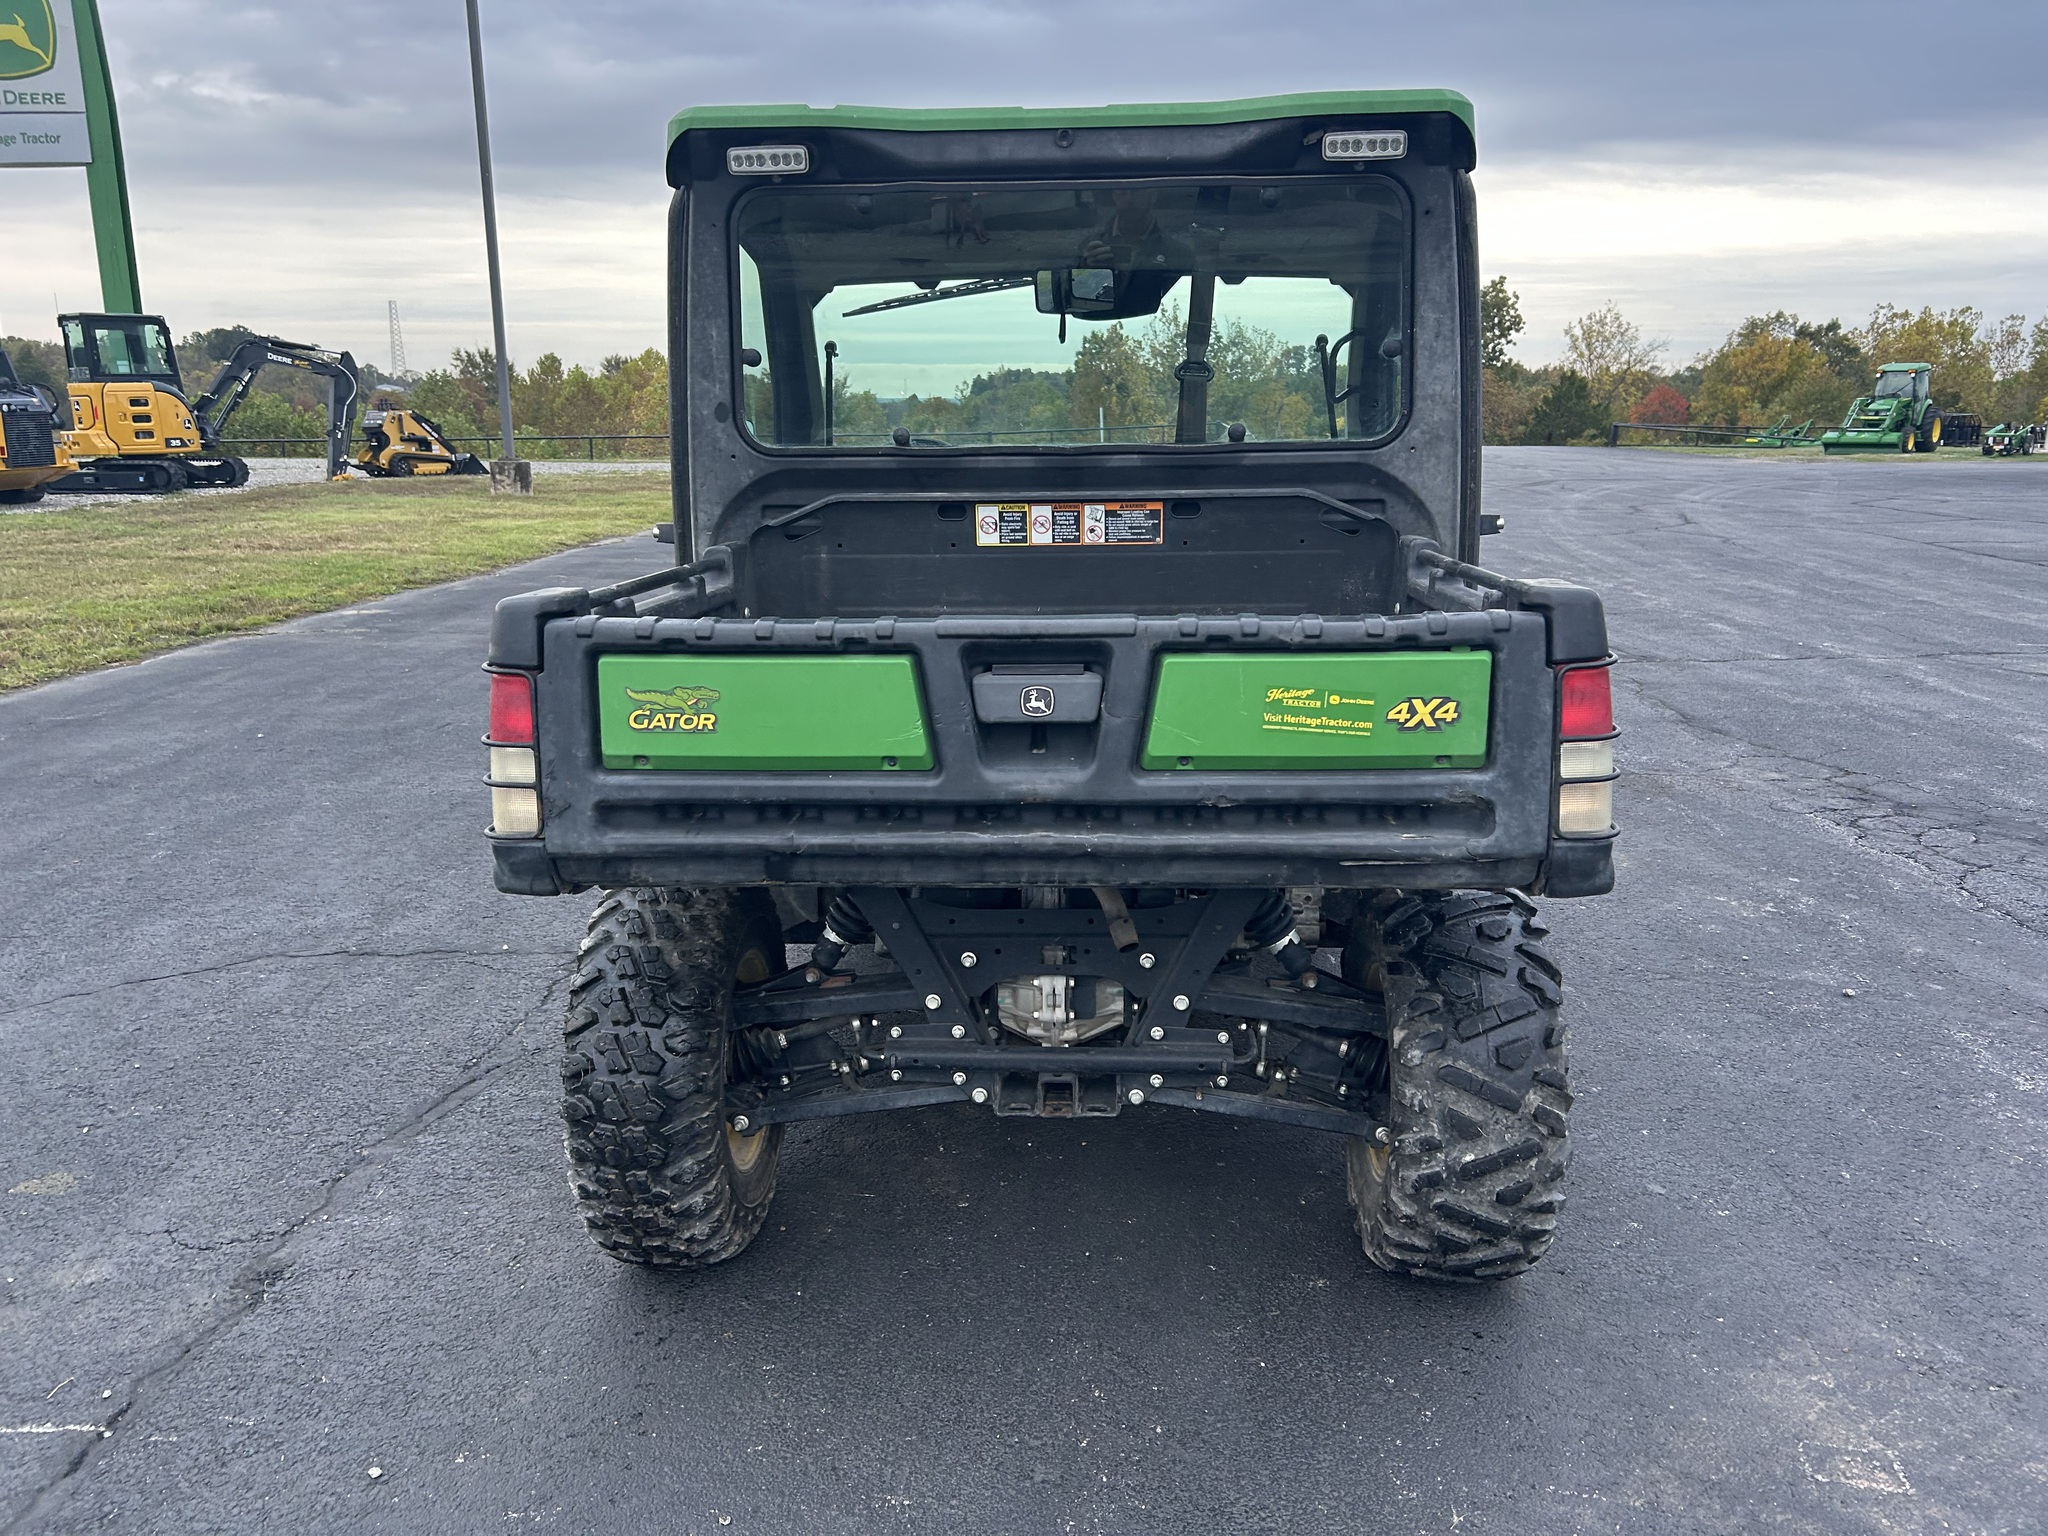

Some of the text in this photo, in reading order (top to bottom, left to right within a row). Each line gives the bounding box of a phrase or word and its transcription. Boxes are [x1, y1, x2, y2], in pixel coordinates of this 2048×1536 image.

[3, 90, 66, 105] DEERE
[20, 132, 61, 144] Tractor
[267, 352, 293, 365] DEERE
[170, 439, 182, 447] 35
[1265, 687, 1315, 702] Heritage
[1282, 699, 1321, 708] TRACTOR
[628, 709, 716, 730] GATOR
[1263, 712, 1373, 729] Visit HeritageTractor.com
[1386, 697, 1459, 729] 4X4
